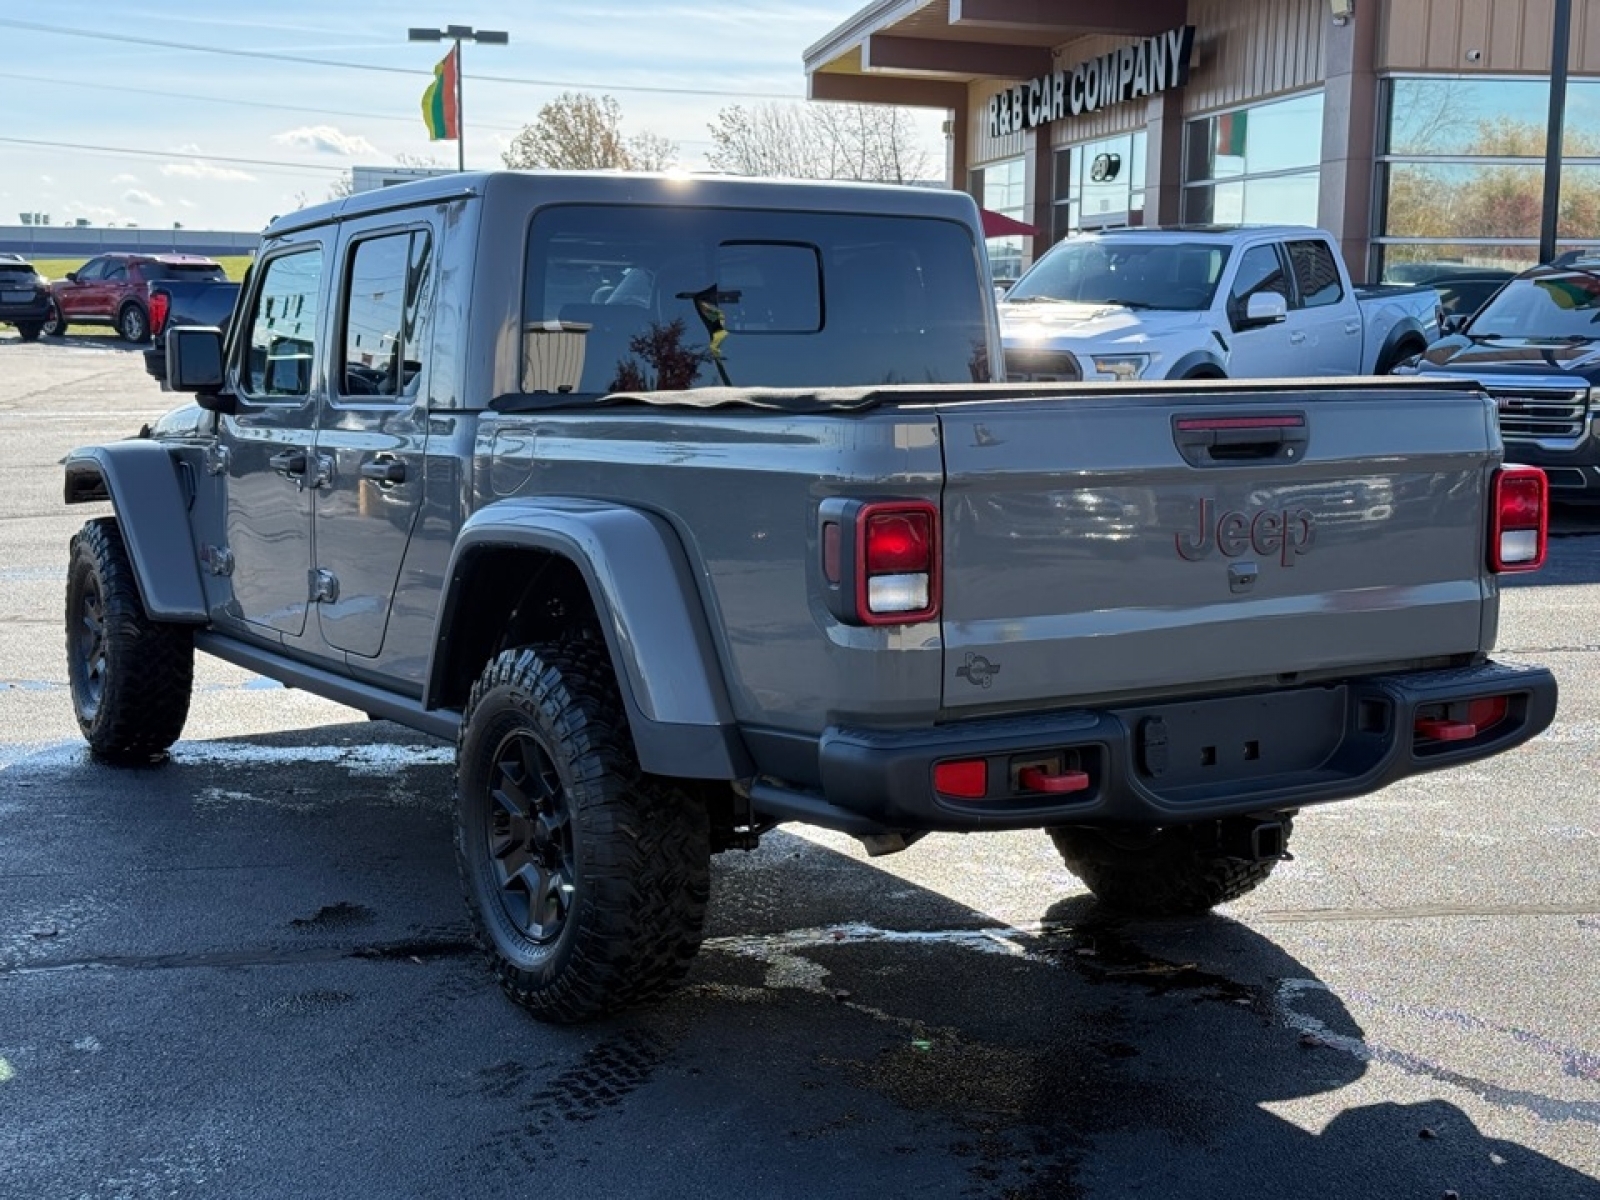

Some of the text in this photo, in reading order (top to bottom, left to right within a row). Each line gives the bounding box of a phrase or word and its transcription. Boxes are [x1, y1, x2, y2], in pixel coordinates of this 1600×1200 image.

[989, 25, 1187, 137] R&B CAR COMPANY
[1174, 497, 1317, 567] Jeep
